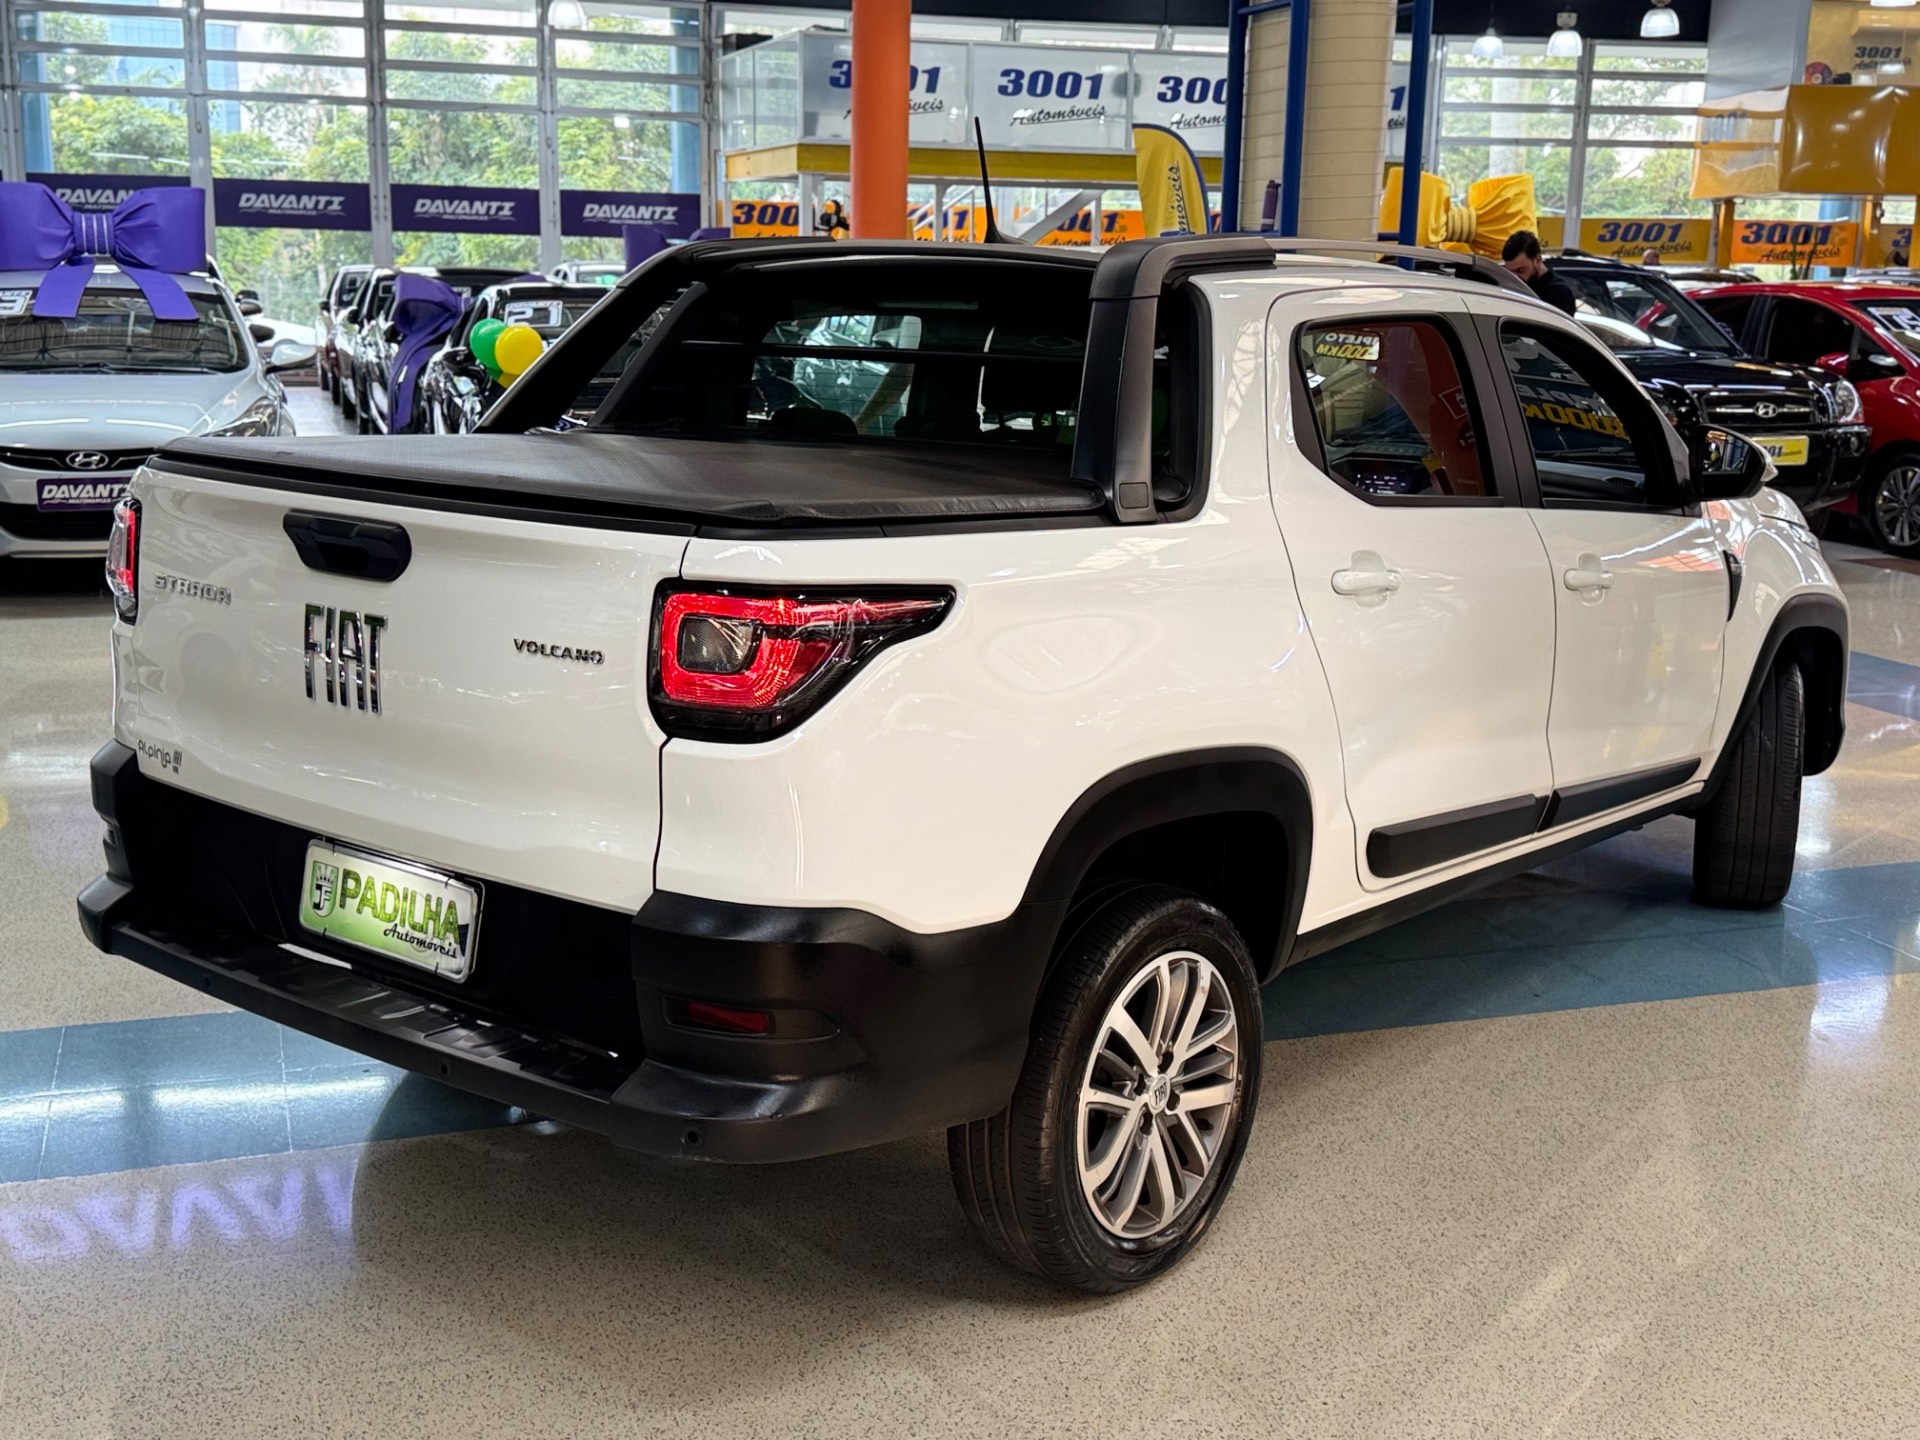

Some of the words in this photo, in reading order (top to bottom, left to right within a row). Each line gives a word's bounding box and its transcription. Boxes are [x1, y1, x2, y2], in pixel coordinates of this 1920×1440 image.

[1854, 46, 1902, 58] 3001
[998, 68, 1104, 100] 3001
[1010, 104, 1106, 127] Automóveis
[238, 193, 346, 211] DAVANTI
[413, 198, 516, 216] DAVANTI
[582, 203, 679, 220] DAVANTI
[1597, 222, 1683, 243] 3001
[1741, 222, 1832, 246] 3001
[154, 573, 232, 605] STRADA
[304, 603, 389, 715] FIAT
[513, 638, 605, 665] VOLCANO
[339, 868, 460, 946] PADILHA
